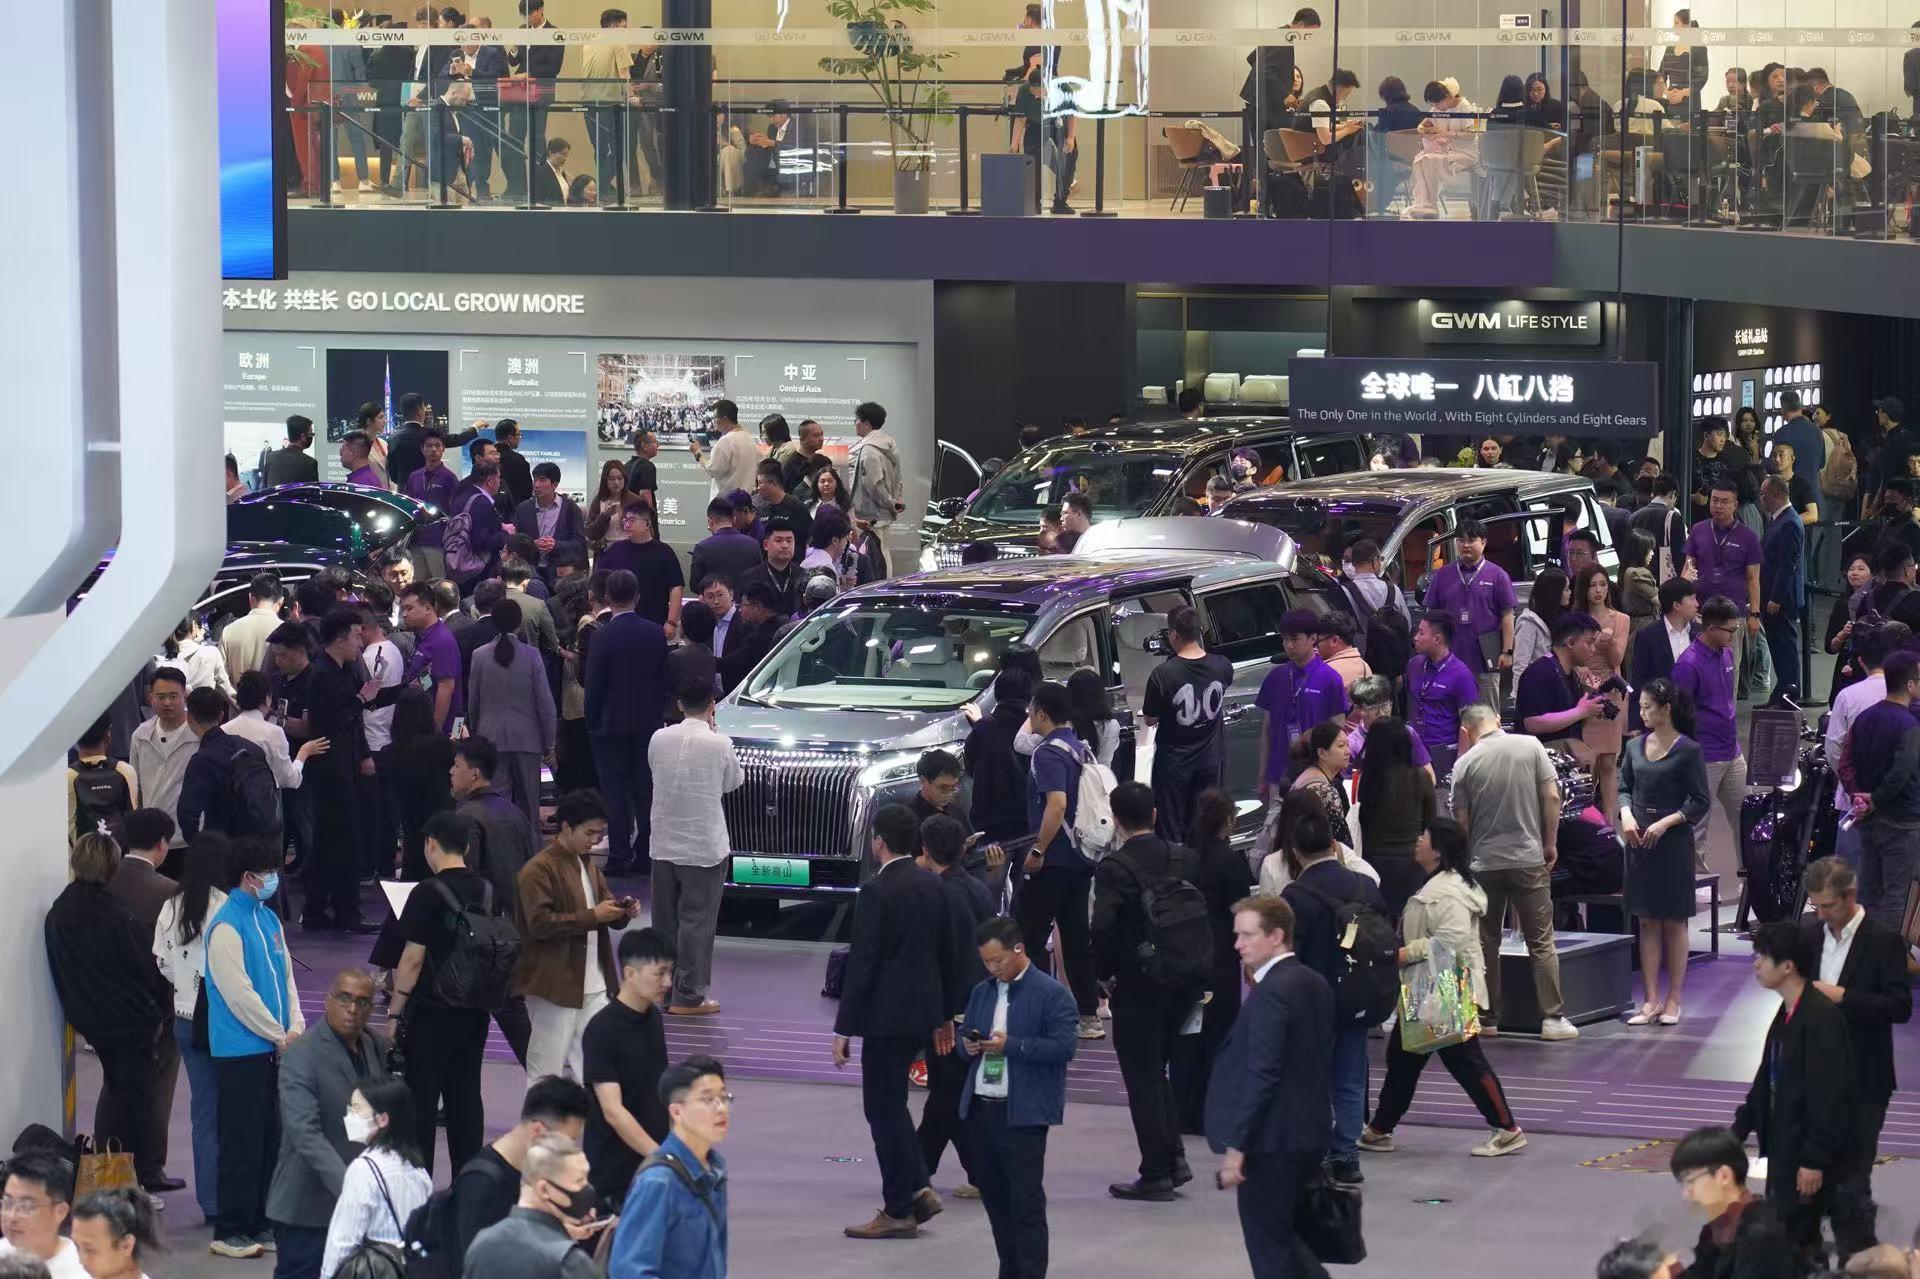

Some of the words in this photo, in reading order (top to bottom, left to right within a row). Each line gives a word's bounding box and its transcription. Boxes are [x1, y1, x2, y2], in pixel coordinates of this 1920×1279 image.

[286, 33, 307, 41] WM
[372, 33, 404, 41] GWM
[670, 32, 704, 41] GWM
[772, 32, 807, 41] GWM
[981, 32, 1015, 41] GWM
[1414, 32, 1452, 42] GWM
[1516, 32, 1552, 42] GWM
[1709, 32, 1726, 42] GWM
[1806, 32, 1824, 42] GWM
[1856, 32, 1874, 42] GWM
[357, 92, 377, 101] WM
[222, 288, 277, 310] 本土化
[284, 289, 338, 310] 共生长
[347, 291, 378, 310] GO
[382, 292, 451, 311] LOCAL
[454, 292, 519, 312] GROW
[523, 294, 584, 314] MORE
[1431, 312, 1501, 329] GWM
[239, 352, 270, 369] 欧洲
[507, 358, 539, 374] 澳洲
[784, 362, 817, 381] 中亚
[242, 372, 266, 382] Europe
[508, 378, 539, 386] Australia
[779, 384, 805, 392] Central
[806, 385, 822, 393] Asia
[1360, 372, 1459, 401] 全球唯一
[1473, 373, 1574, 402] 八缸八挡
[1297, 408, 1317, 420] The
[1320, 410, 1343, 422] Only
[1347, 410, 1368, 420] One
[1371, 410, 1381, 420] in
[1384, 410, 1401, 421] the
[1445, 411, 1472, 422] With
[1475, 412, 1503, 425] Eight
[1506, 412, 1556, 425] Cylinders
[1559, 414, 1580, 424] and
[1583, 414, 1612, 427] Eight
[1614, 414, 1647, 426] Gears
[751, 864, 792, 878] 全新高山
